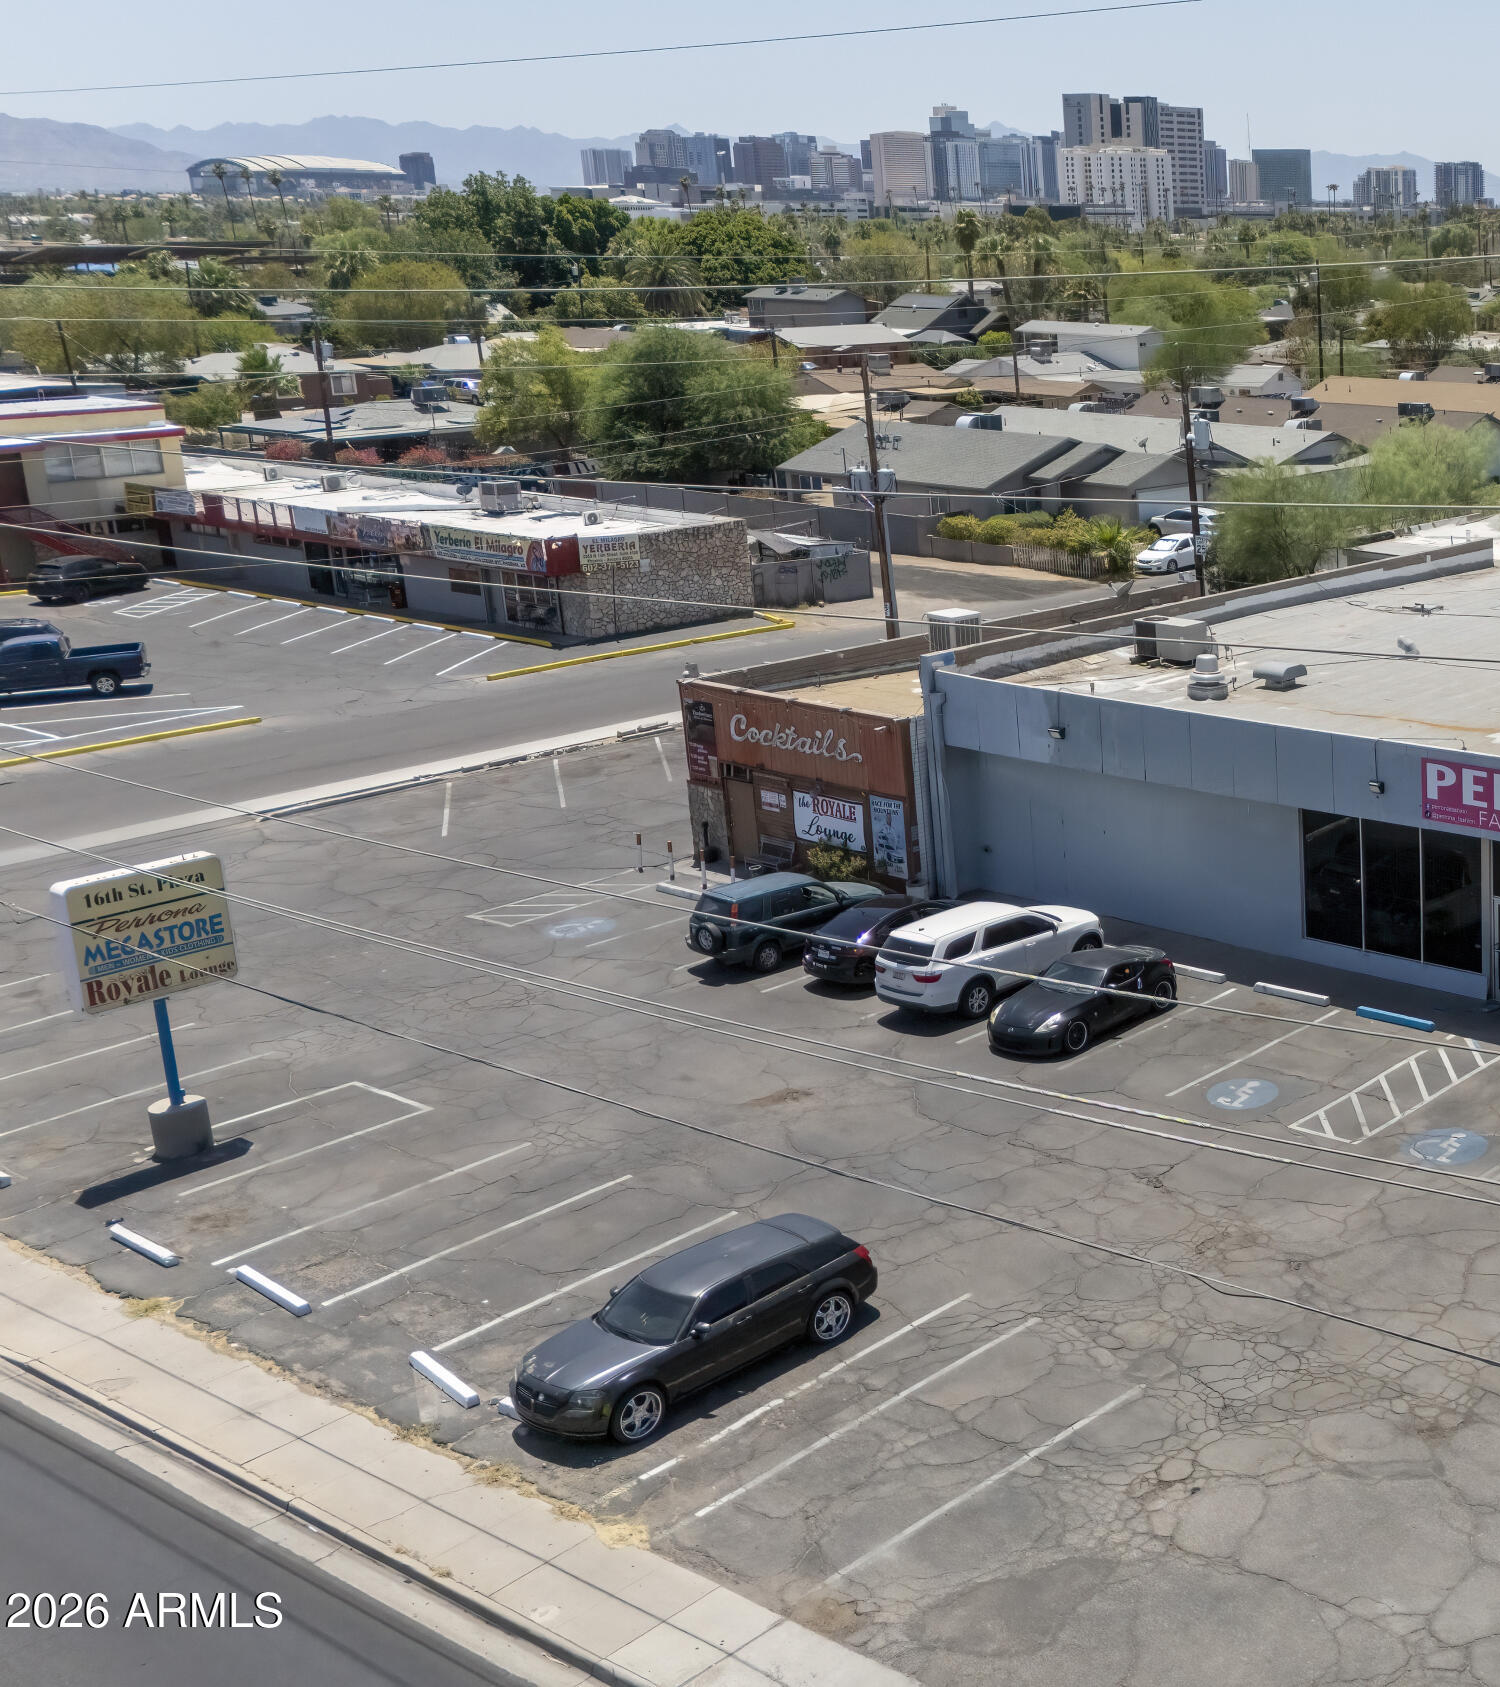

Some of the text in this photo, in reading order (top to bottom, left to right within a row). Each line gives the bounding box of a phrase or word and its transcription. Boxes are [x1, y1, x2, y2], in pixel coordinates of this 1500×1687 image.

[475, 536, 483, 550] El
[486, 537, 524, 557] Milagro
[582, 542, 636, 554] YERBERIA
[730, 714, 862, 763] Cocktails
[798, 796, 811, 808] the
[812, 797, 856, 822] ROYALE
[802, 816, 856, 847] Lounge
[84, 872, 206, 908] 16th St. Plaza
[84, 912, 224, 966] MEGASTORE
[97, 962, 114, 972] MEN
[122, 954, 152, 966] WOMEN
[161, 947, 178, 956] KIDS
[86, 959, 236, 1007] Royale Lounge
